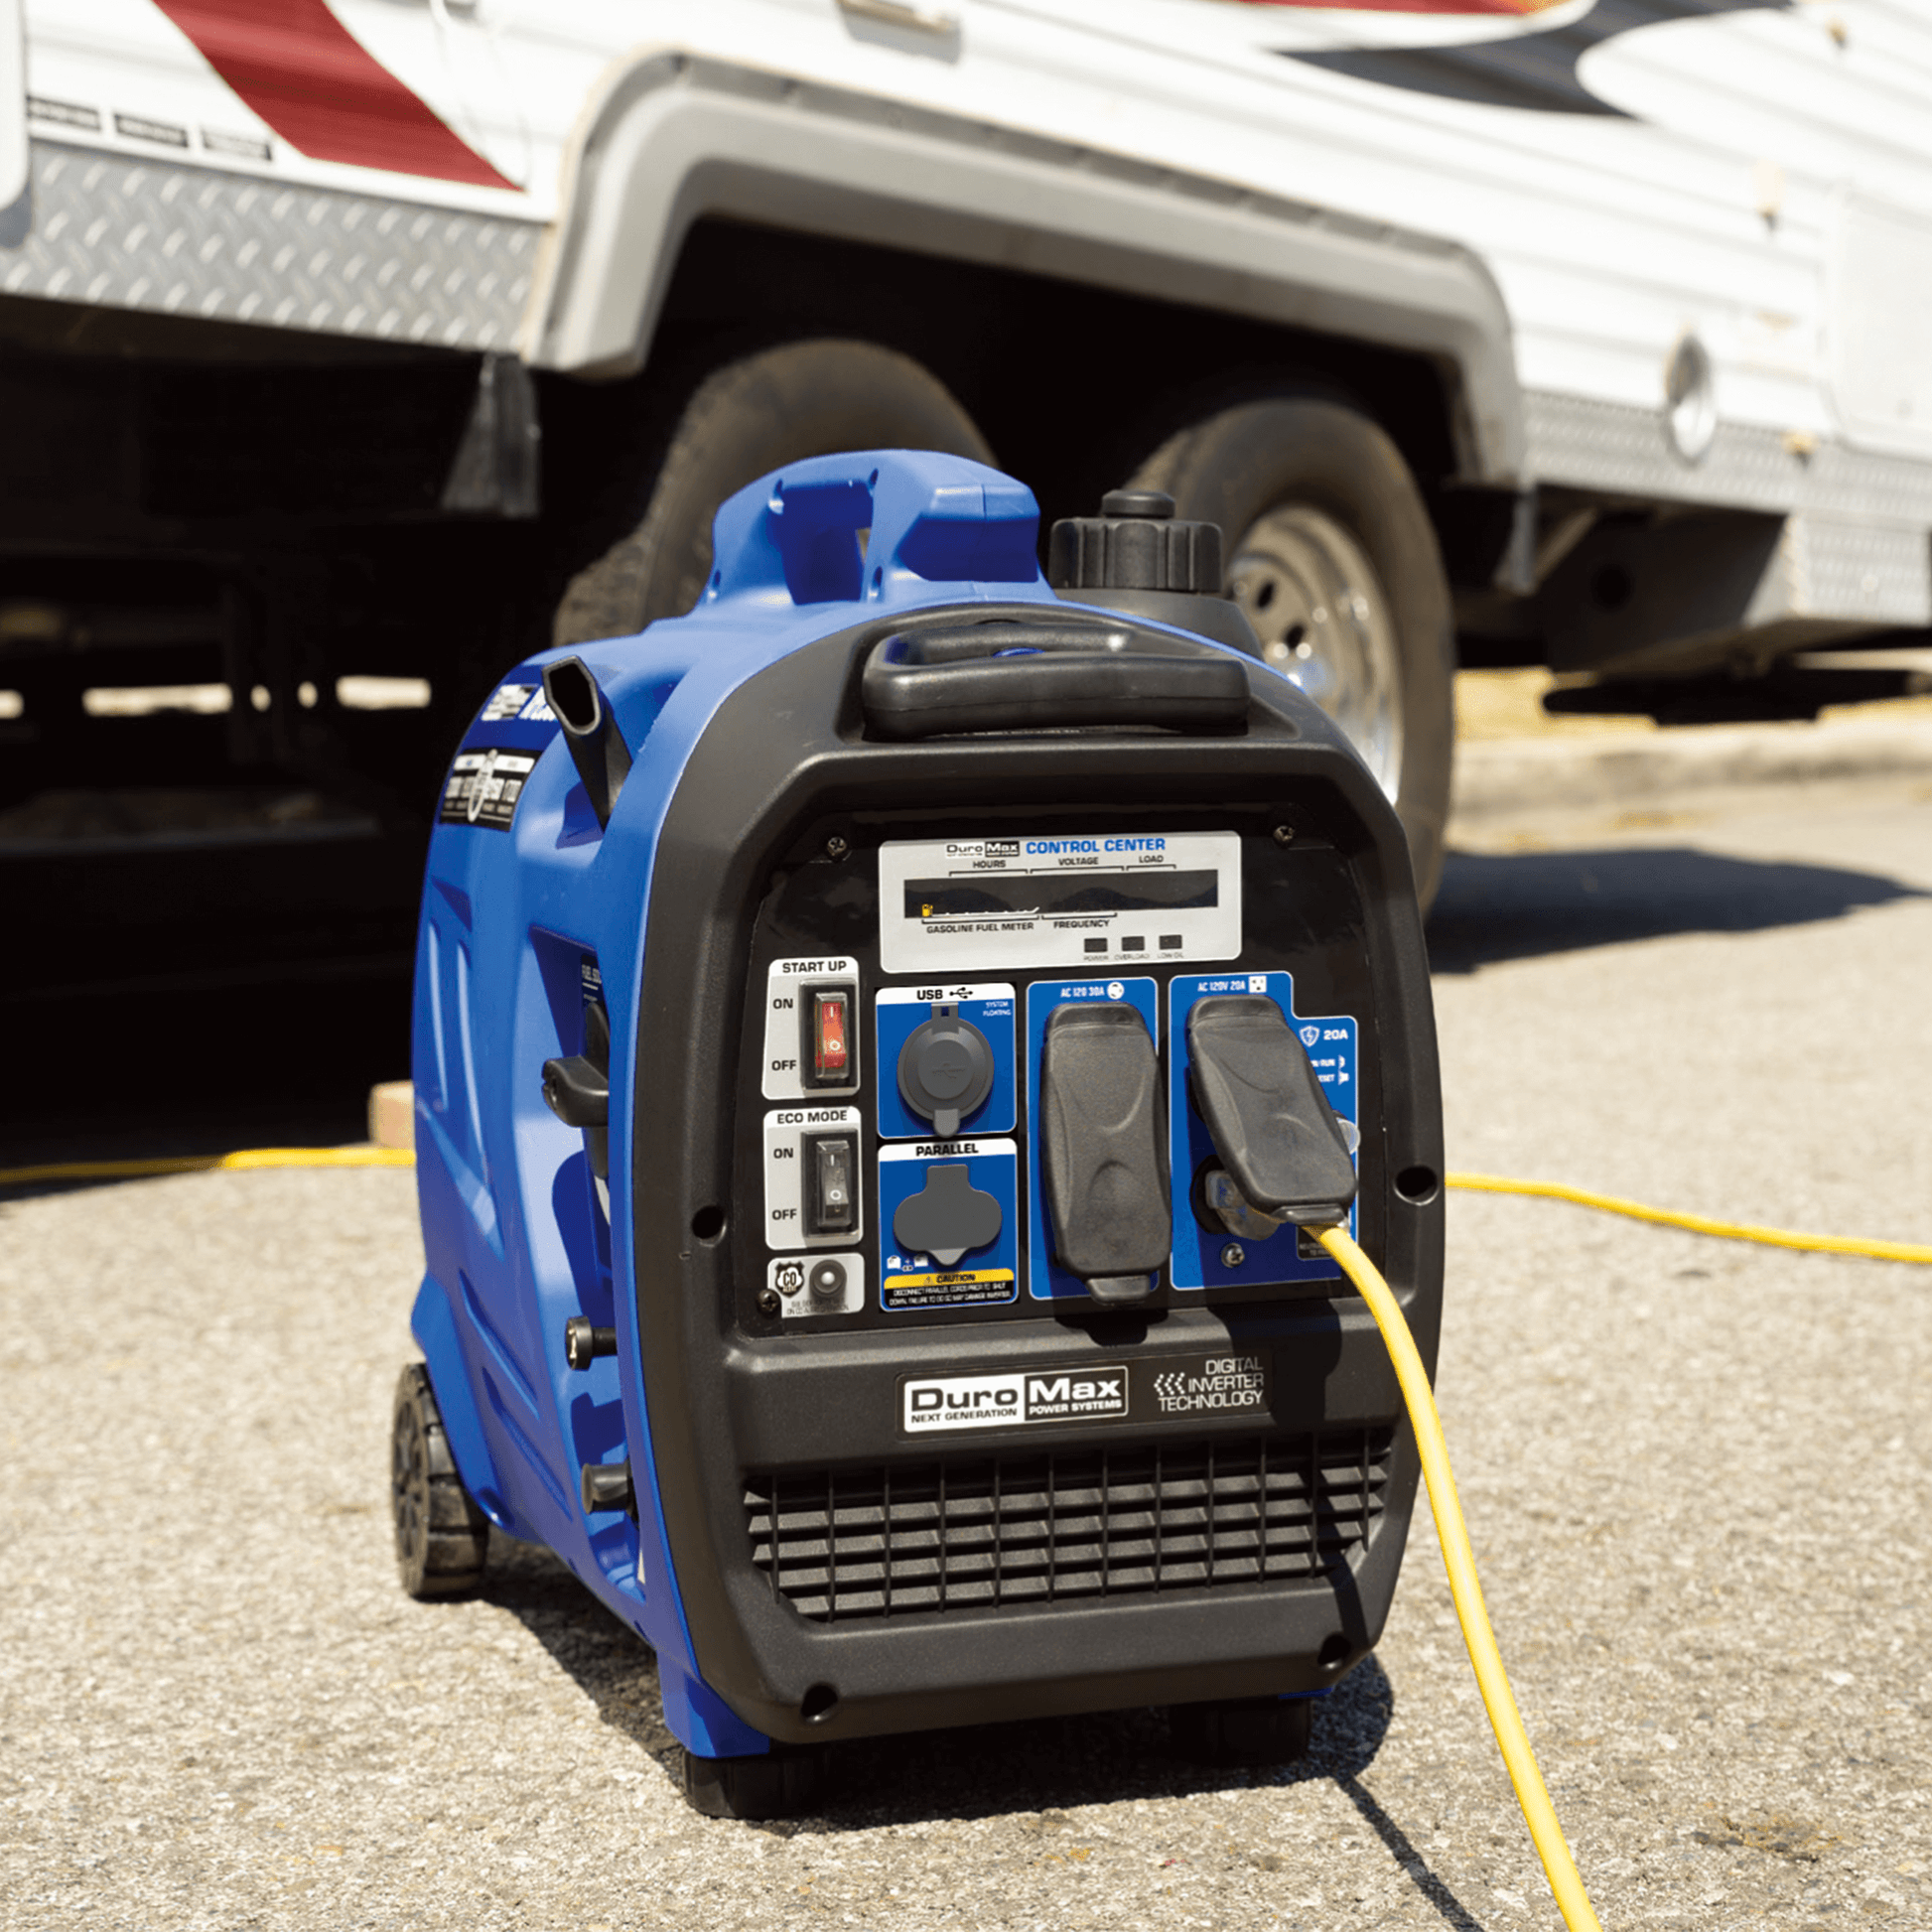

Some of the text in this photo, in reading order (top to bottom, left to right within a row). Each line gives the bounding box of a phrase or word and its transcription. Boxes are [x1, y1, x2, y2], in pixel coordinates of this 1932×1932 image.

[1026, 838, 1166, 854] CONTROL CENTER
[973, 860, 1006, 869] HOURS
[1058, 857, 1099, 866] VOLTAGE
[926, 924, 973, 933] GASOLINE
[1001, 922, 1035, 931] METER
[1053, 919, 1110, 928] FREQUENCY
[782, 960, 847, 973] START UP
[1197, 982, 1208, 992] AC
[1229, 980, 1246, 991] 20A
[916, 989, 943, 1001] USB
[1060, 988, 1071, 998] AC
[772, 998, 794, 1010] ON
[1323, 1029, 1348, 1040] 20A
[771, 1059, 796, 1071] OFF
[777, 1110, 848, 1124] ECO MODE
[773, 1148, 794, 1159] ON
[915, 1143, 979, 1157] PARALLEL
[771, 1208, 797, 1220] OFF
[782, 1272, 797, 1286] CO
[935, 1273, 976, 1284] CAUTION
[1205, 1356, 1264, 1375] DIGITAL
[1188, 1372, 1264, 1393] INVERTER
[910, 1377, 1121, 1412] Duro Max
[1158, 1389, 1263, 1412] TECHNOLOGY
[1029, 1399, 1123, 1416] POWER SYSTEMS
[910, 1407, 1018, 1424] NEXT GENERATION
